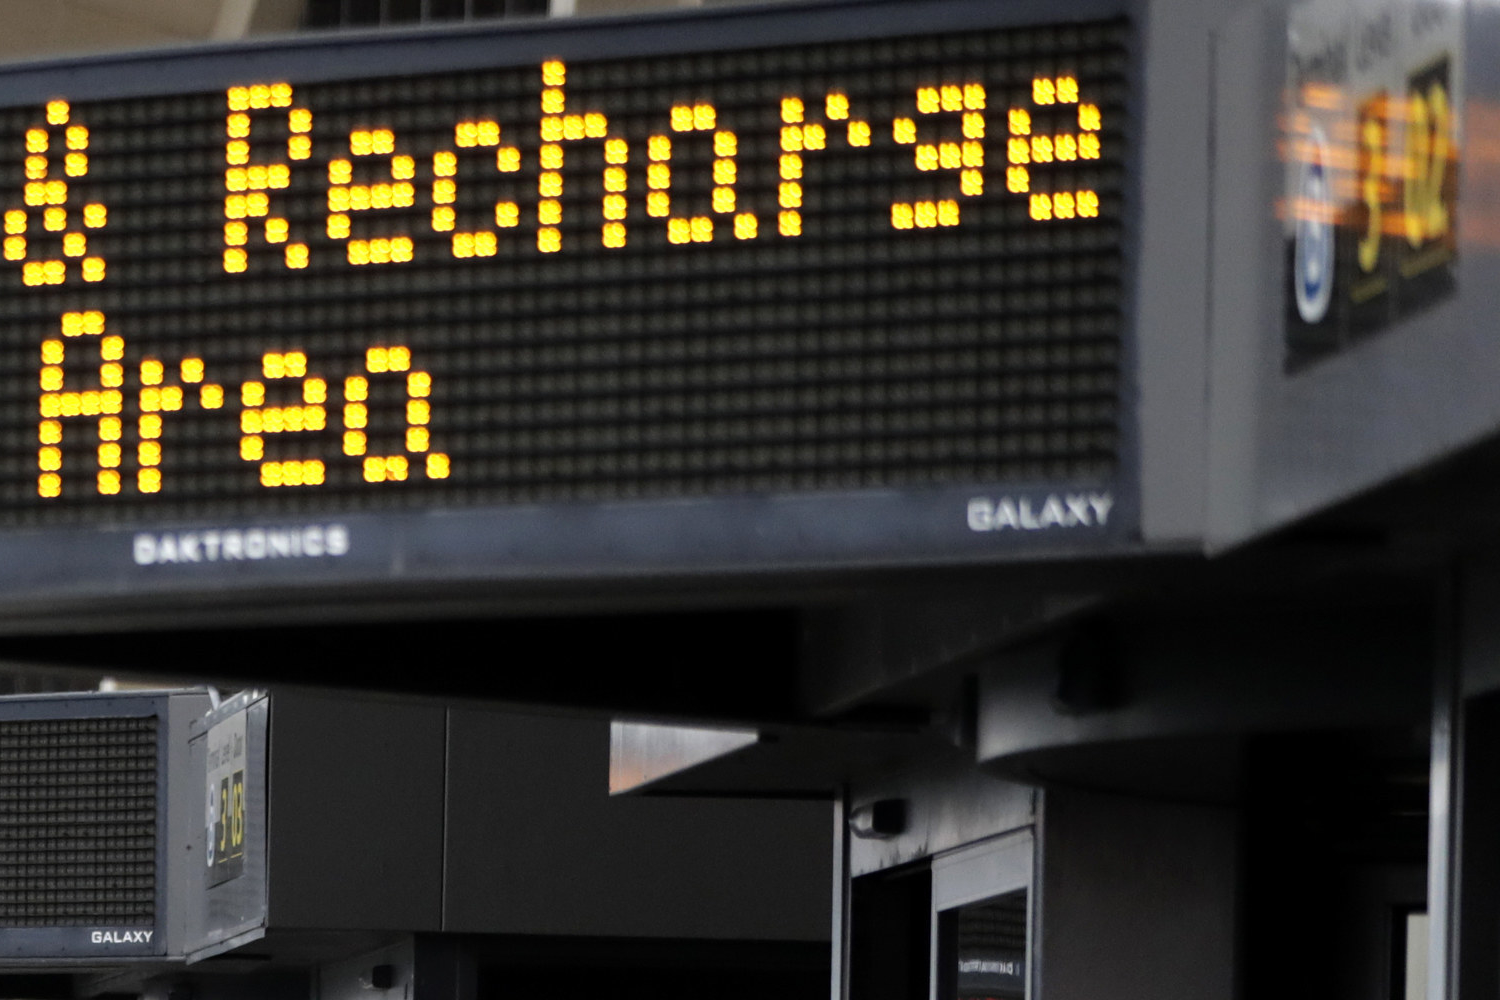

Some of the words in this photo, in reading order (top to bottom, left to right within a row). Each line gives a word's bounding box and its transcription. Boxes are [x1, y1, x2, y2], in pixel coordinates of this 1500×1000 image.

[2, 99, 107, 289] &
[223, 59, 1102, 274] Recharge
[37, 310, 451, 498] Area
[966, 494, 1114, 532] GALAXY
[132, 524, 349, 566] DAKTRONICS
[90, 930, 153, 945] GALAXY
